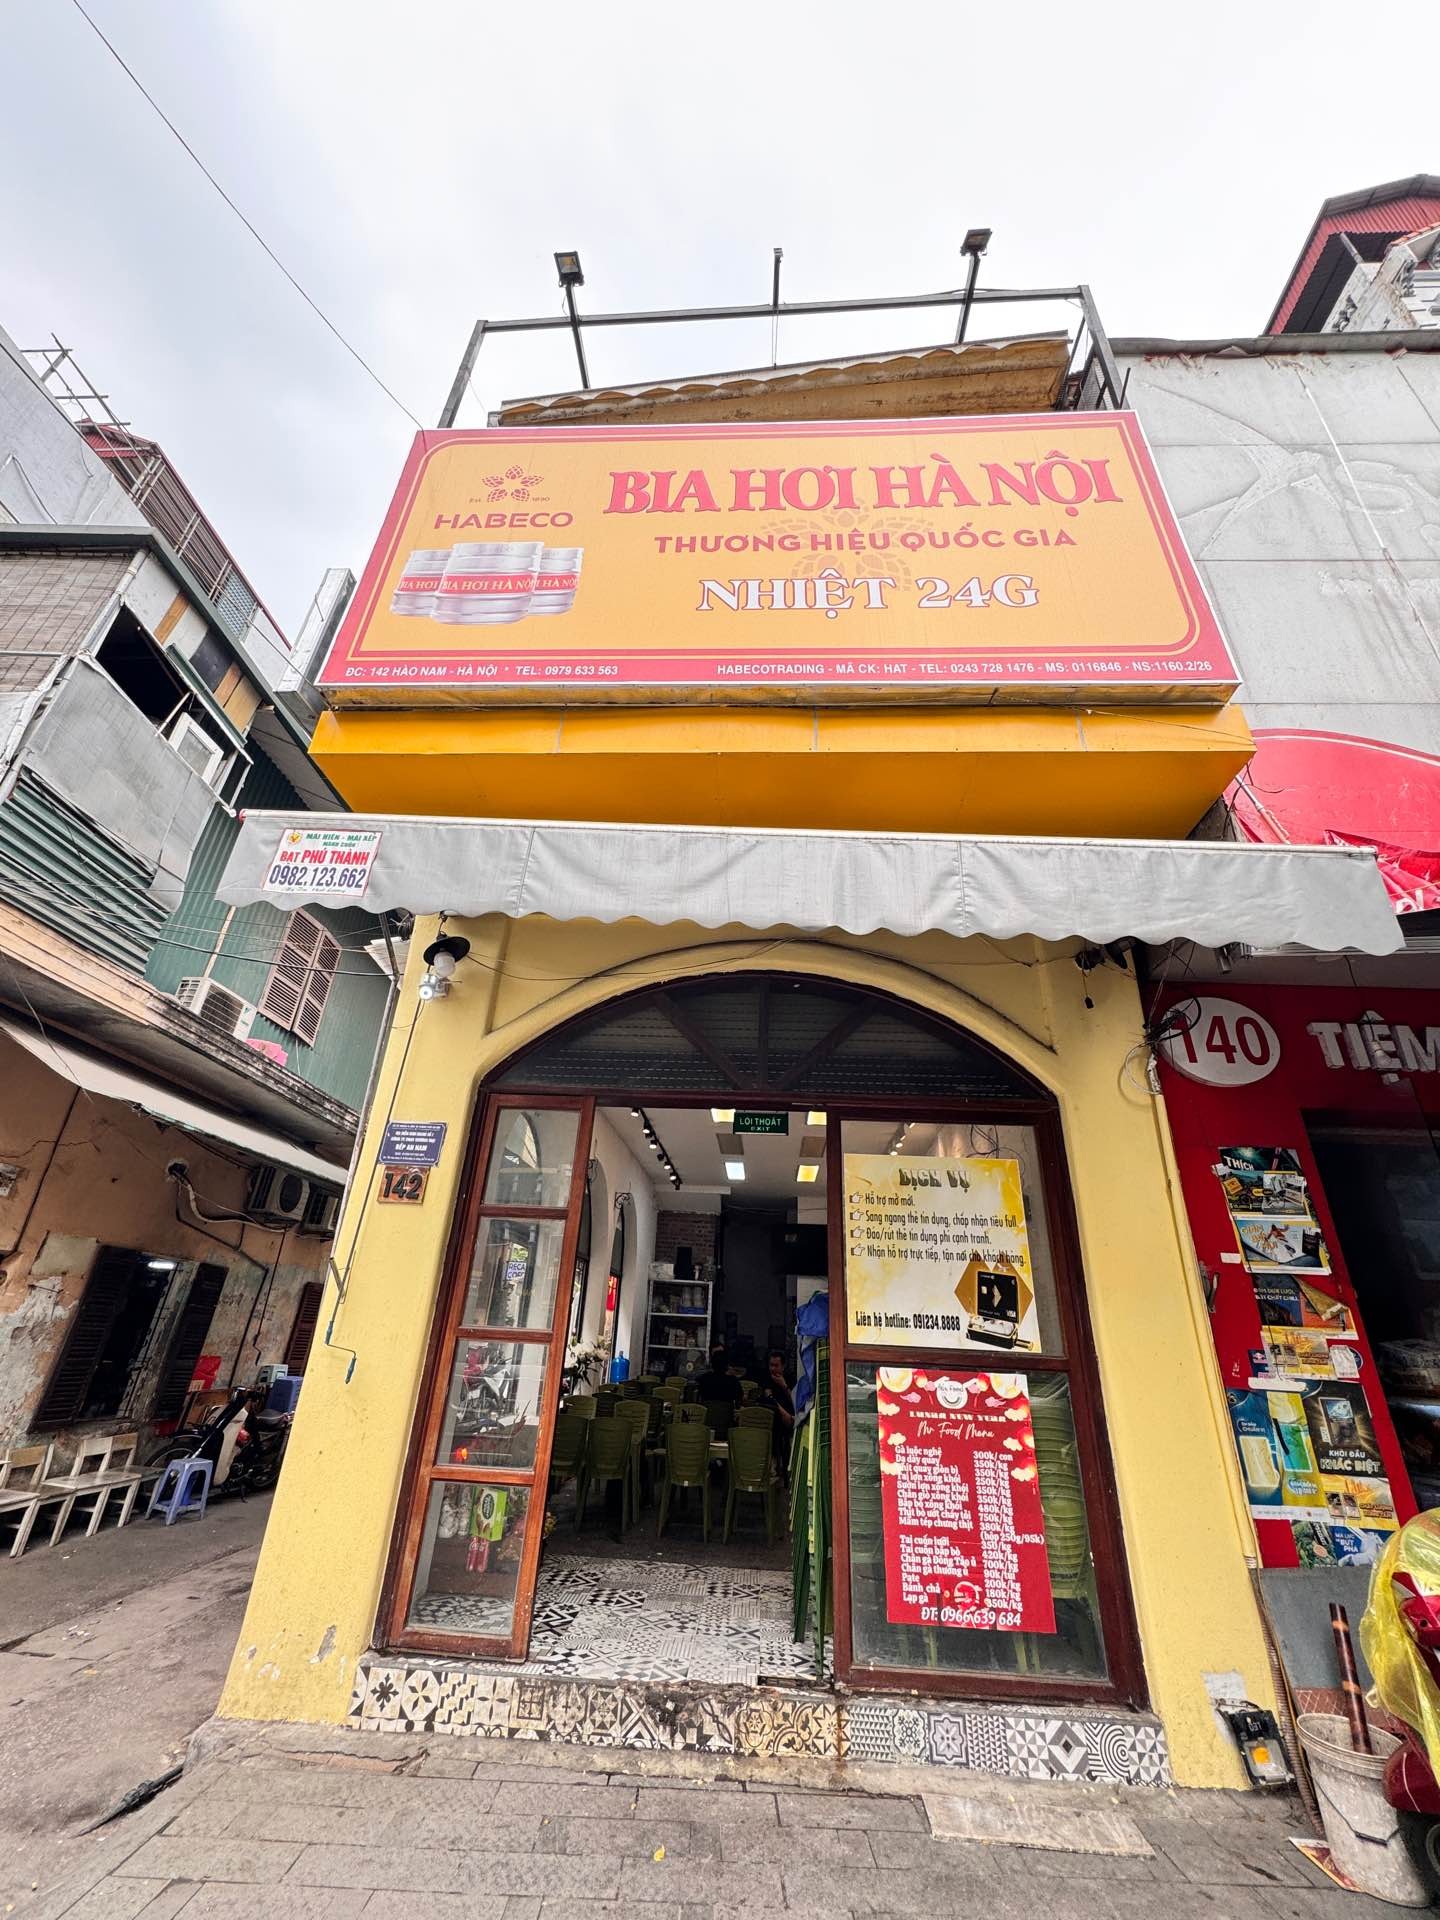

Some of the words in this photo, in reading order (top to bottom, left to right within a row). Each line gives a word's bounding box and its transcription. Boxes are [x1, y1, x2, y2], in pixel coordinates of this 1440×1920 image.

[603, 469, 722, 514] BIA
[728, 466, 861, 511] HƠI
[868, 452, 982, 508] HÀ
[979, 450, 1124, 517] NỘI
[434, 512, 574, 529] HABECO
[654, 534, 801, 554] THƯƠNG
[811, 527, 891, 555] HIỆU
[900, 522, 1006, 552] QUỐC
[1013, 529, 1078, 547] GIA
[696, 568, 897, 619] NHIỆT
[915, 574, 1040, 609] 24G
[346, 667, 367, 677] ĐC:
[370, 667, 389, 677] 142
[392, 663, 418, 677] HÀO
[420, 666, 446, 676] NAM
[457, 663, 474, 676] HÀ
[477, 663, 498, 678] NỘI
[515, 666, 542, 676] TEL:
[545, 665, 572, 676] 0979
[575, 665, 595, 676] 633
[598, 665, 618, 676] 563
[717, 664, 825, 675] HABECOTRADING
[858, 664, 880, 674] CK:
[884, 664, 907, 674] HAT
[919, 663, 947, 674] TEL:
[950, 663, 979, 674] 0243
[981, 663, 1003, 673] 728
[1006, 663, 1034, 673] 1476
[1045, 662, 1069, 673] MS:
[1072, 662, 1122, 673] 0116846
[301, 847, 328, 864] PHÚ
[269, 864, 367, 888] 0982.123.662
[1171, 1015, 1270, 1066] 140
[383, 1172, 423, 1200] 142
[899, 1168, 942, 1191] DỊCH
[947, 1169, 971, 1193] VỤ
[865, 1210, 883, 1225] Sang
[884, 1213, 906, 1226] ngang
[920, 1231, 938, 1245] dụng
[867, 1245, 885, 1259] Nhận
[855, 1310, 872, 1326] Liên
[873, 1311, 883, 1328] hệ
[885, 1312, 911, 1329] hotline:
[913, 1313, 961, 1331] 091234.8888
[949, 1412, 974, 1421] NEW
[937, 1421, 963, 1440] Food
[965, 1423, 994, 1440] Menu
[999, 1454, 1014, 1462] con
[1320, 1457, 1353, 1472] KHÁC
[1354, 1460, 1381, 1474] BIỆT
[921, 1606, 938, 1621] ĐT:
[940, 1607, 970, 1622] 0966
[973, 1610, 996, 1625] 639
[999, 1611, 1022, 1627] 684
